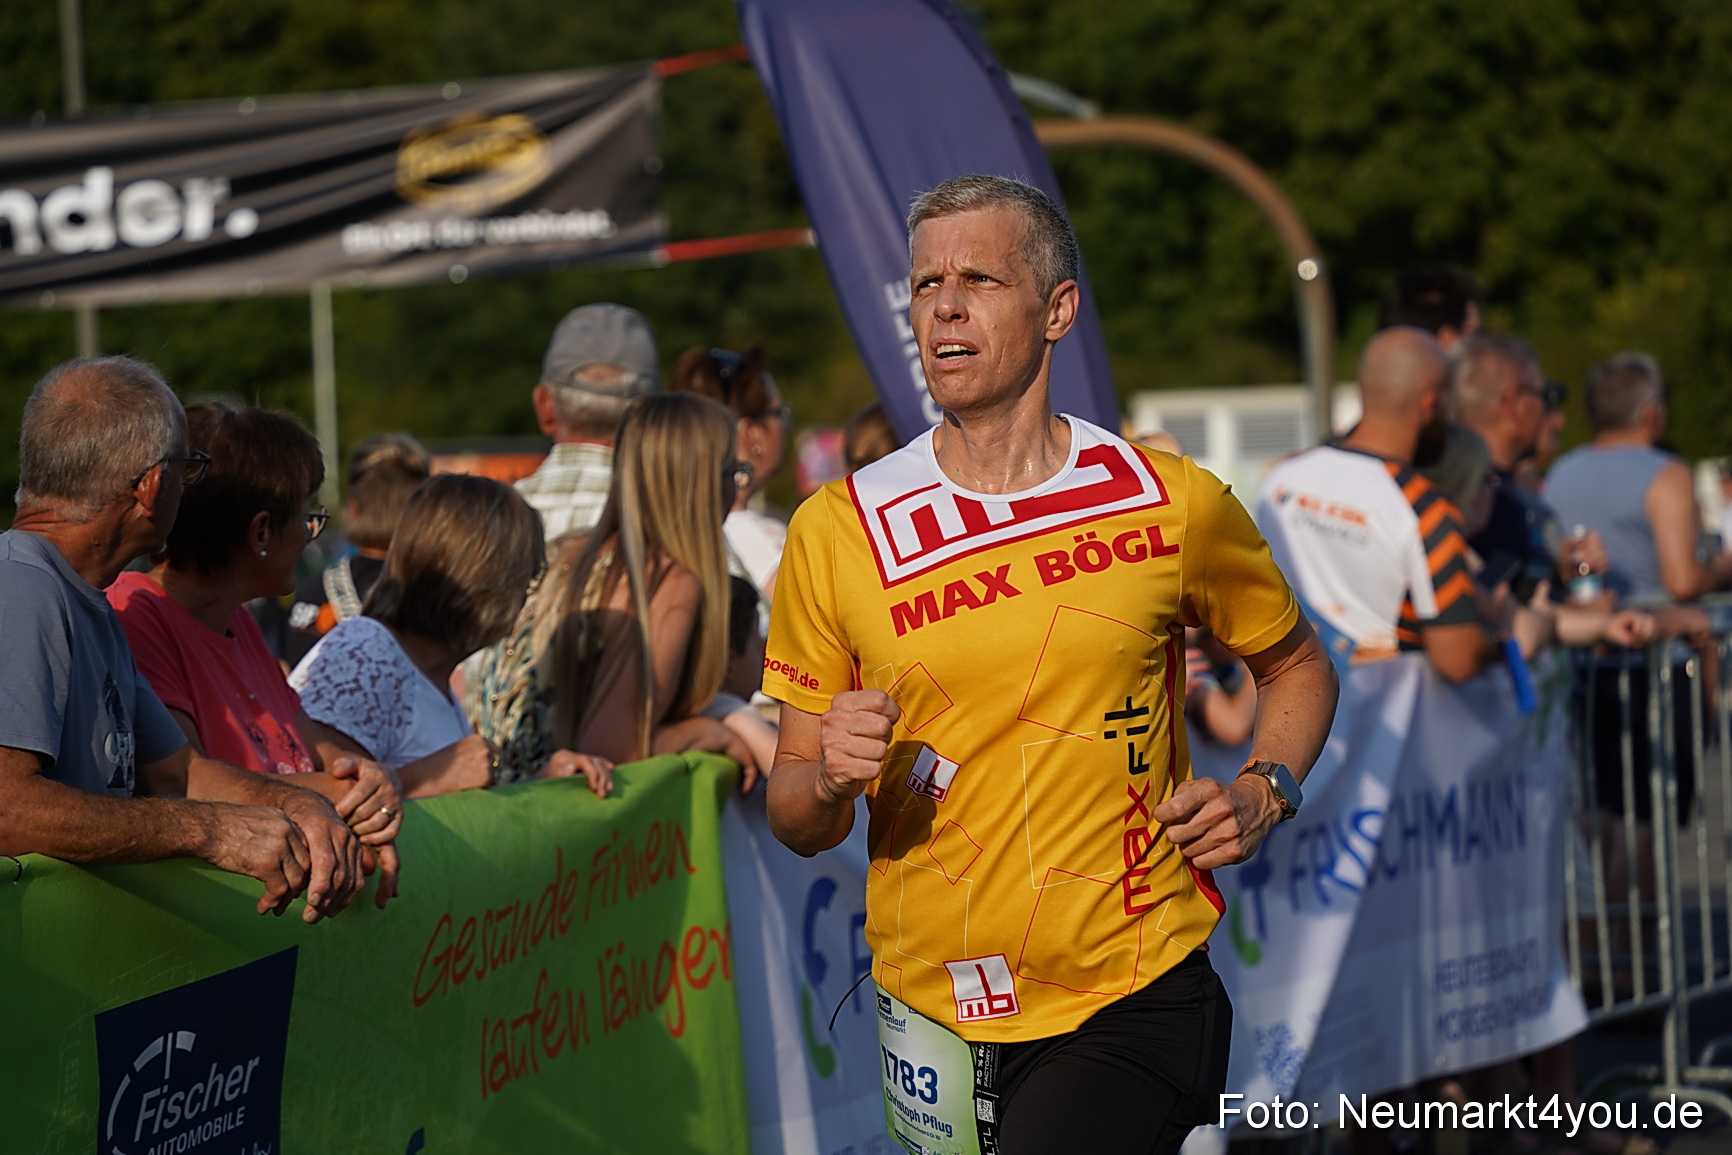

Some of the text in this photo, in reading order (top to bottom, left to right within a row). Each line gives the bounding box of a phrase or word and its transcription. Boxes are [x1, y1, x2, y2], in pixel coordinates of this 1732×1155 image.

[889, 525, 1180, 638] MAX BÖGL
[413, 845, 579, 1008] Gesunde
[480, 921, 732, 1099] laufen länger
[134, 1056, 260, 1143] Fischer
[881, 1043, 938, 1105] 1783
[885, 1086, 921, 1124] Christoph
[922, 1112, 953, 1138] Pflug
